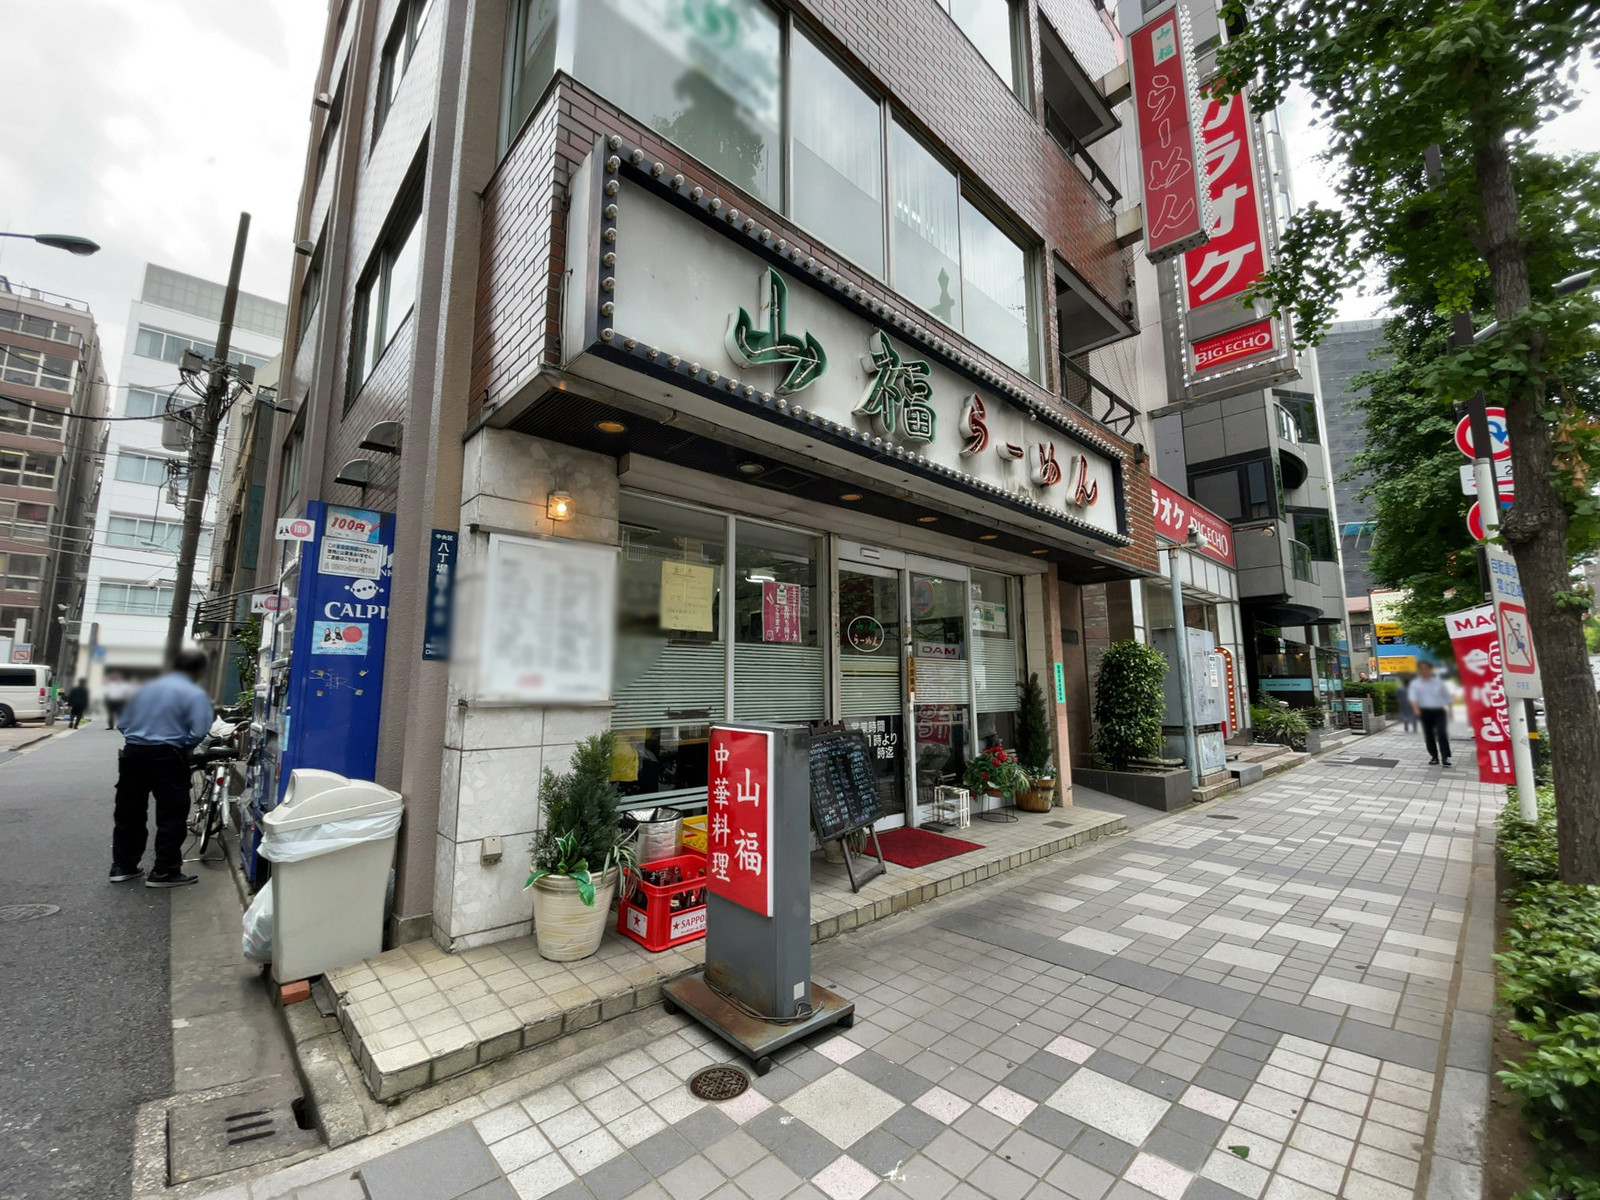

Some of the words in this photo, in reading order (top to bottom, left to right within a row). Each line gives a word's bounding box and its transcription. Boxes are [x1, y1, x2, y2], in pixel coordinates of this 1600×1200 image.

[1156, 26, 1174, 62] 山福
[1147, 75, 1194, 239] らーめん
[1195, 346, 1224, 368] BIG
[1225, 332, 1271, 354] ECHO
[331, 516, 367, 533] 100円
[435, 533, 454, 542] 中央区
[324, 601, 390, 620] CALPI
[922, 645, 956, 655] DAM
[711, 742, 731, 883] 中華料理
[733, 767, 763, 877] 山福
